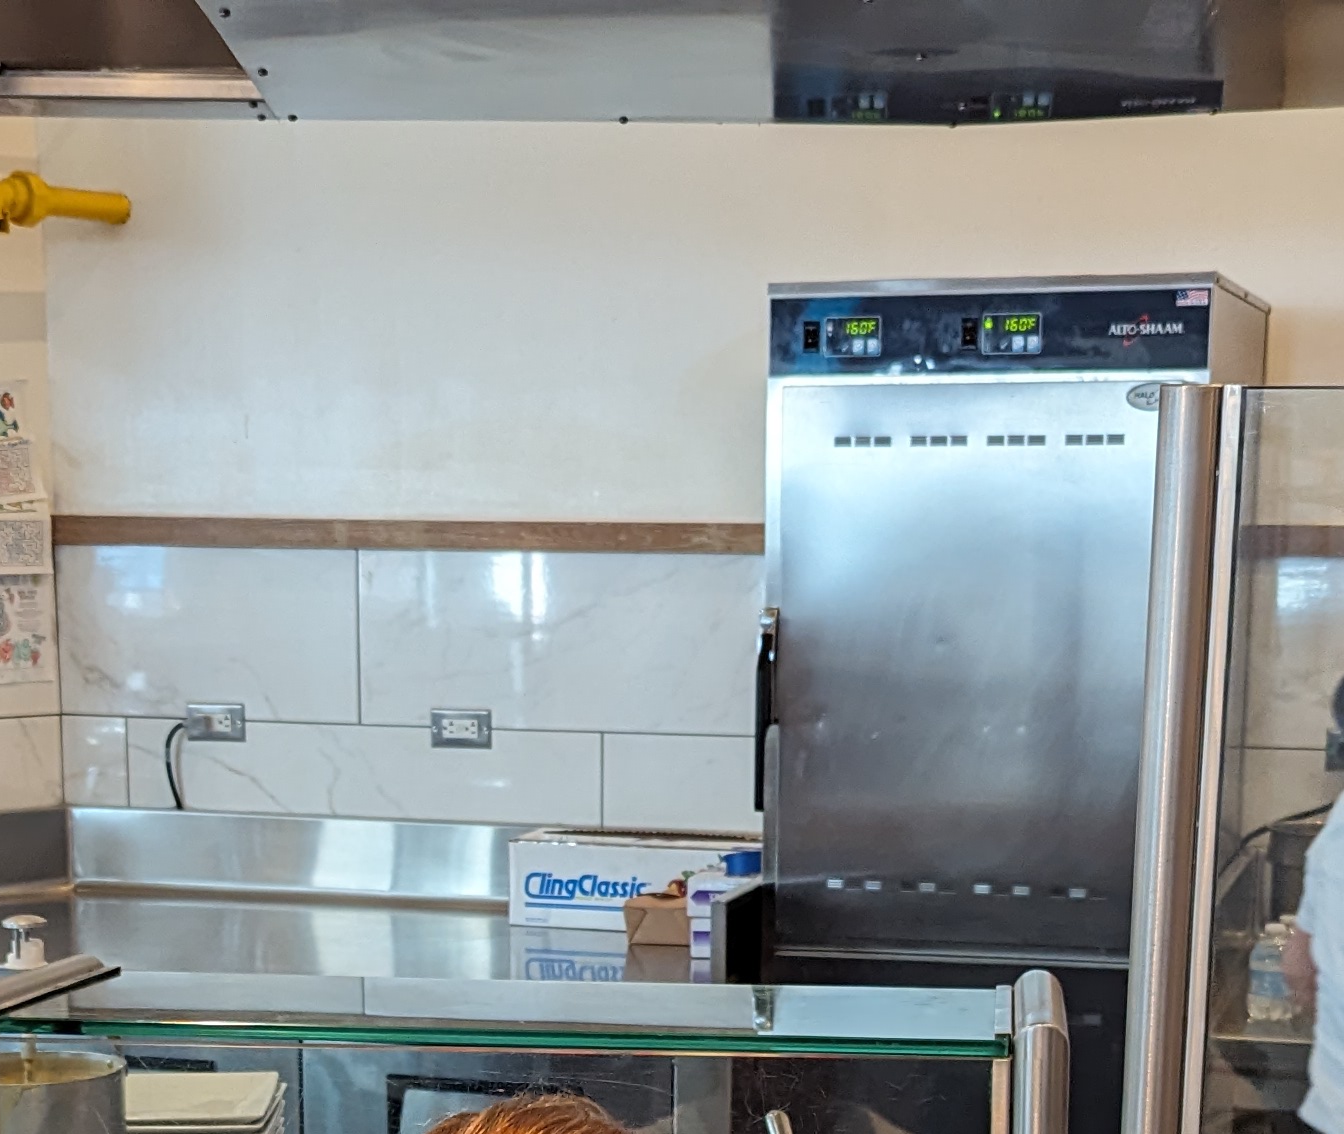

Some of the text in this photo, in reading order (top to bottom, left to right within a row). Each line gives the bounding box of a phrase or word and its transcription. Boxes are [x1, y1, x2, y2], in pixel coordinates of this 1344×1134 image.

[845, 321, 876, 336] 160F
[1005, 317, 1036, 332] 160F
[1108, 322, 1184, 336] ALTO-SHAAM
[524, 871, 648, 900] ClingClassic
